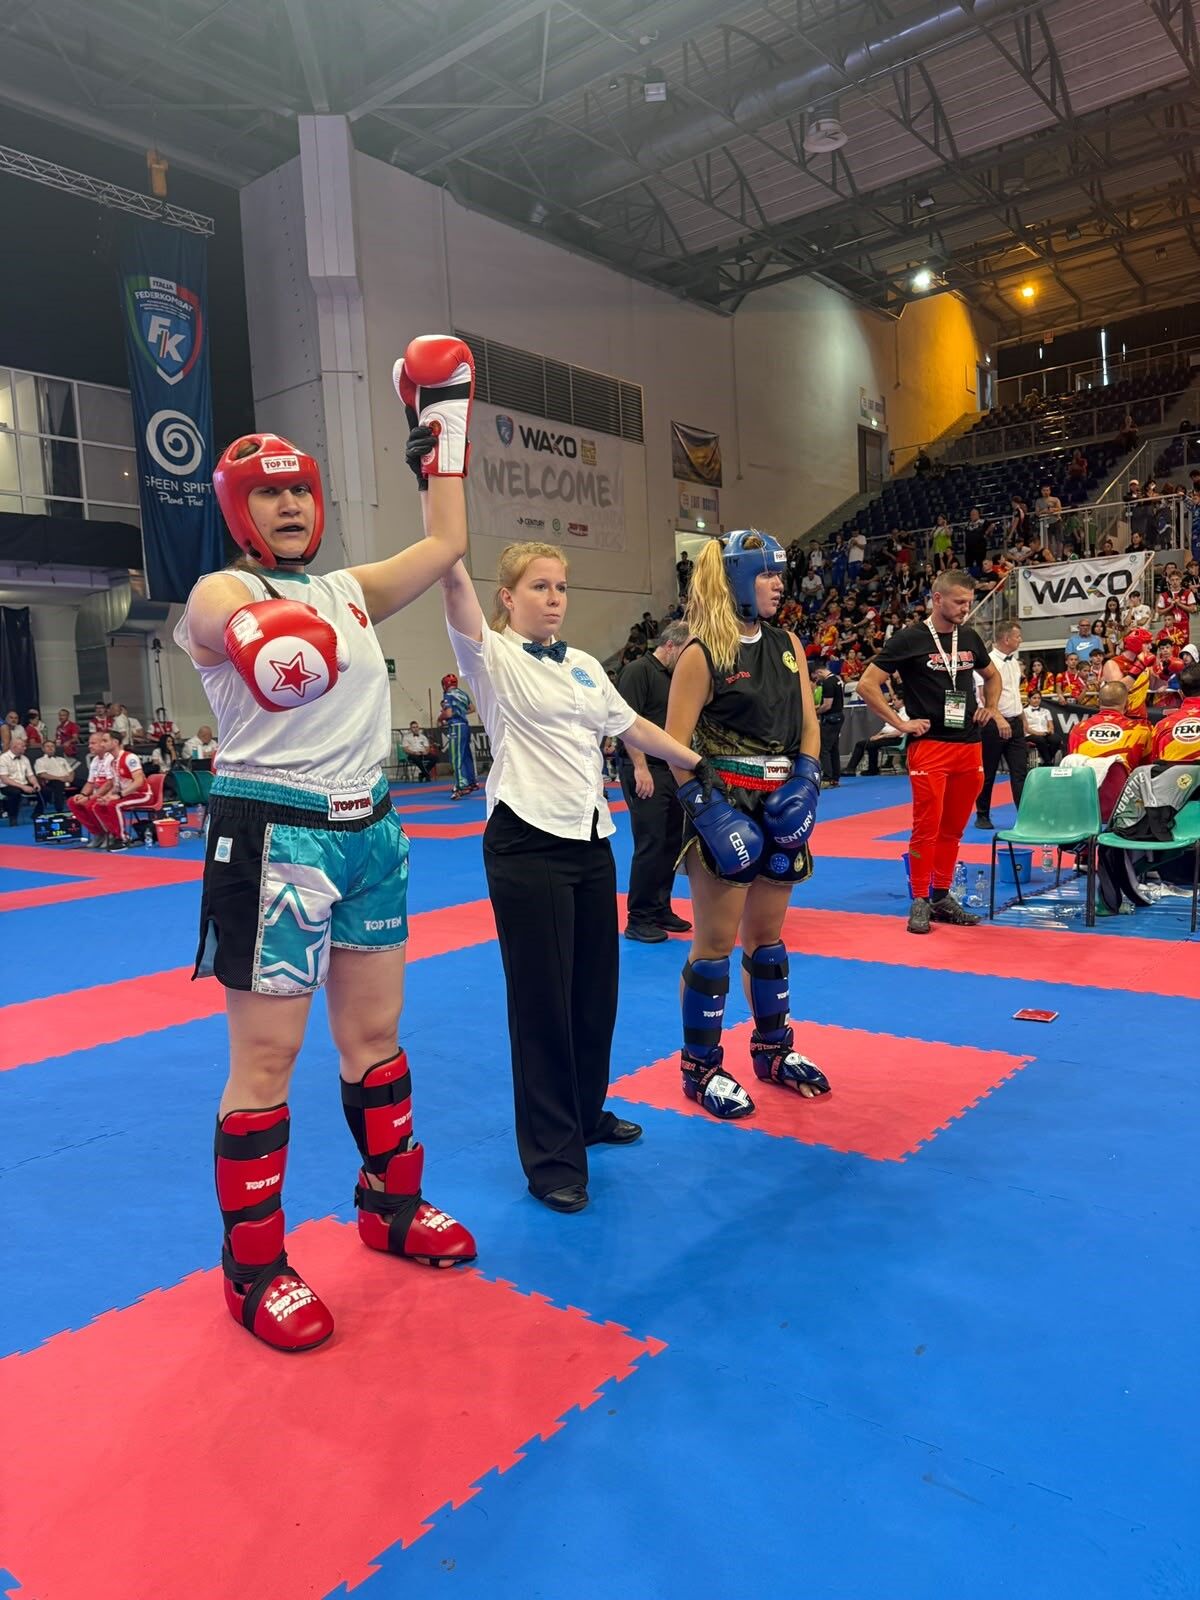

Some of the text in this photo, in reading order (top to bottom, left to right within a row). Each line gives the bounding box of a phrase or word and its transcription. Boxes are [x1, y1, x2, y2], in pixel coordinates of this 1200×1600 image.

[134, 290, 194, 312] FEDERKOMBAT
[518, 424, 577, 459] WAKO
[265, 459, 297, 469] TOP TEN
[482, 456, 613, 508] WELCOME
[1030, 569, 1133, 604] WAKO
[1089, 730, 1121, 738] FEKM
[774, 810, 814, 844] CENTURY
[729, 831, 751, 868] CENTU
[364, 915, 402, 931] TOP TEN
[245, 1179, 265, 1190] TOP
[268, 1294, 292, 1317] TOP
[282, 1297, 312, 1318] FIGHT
